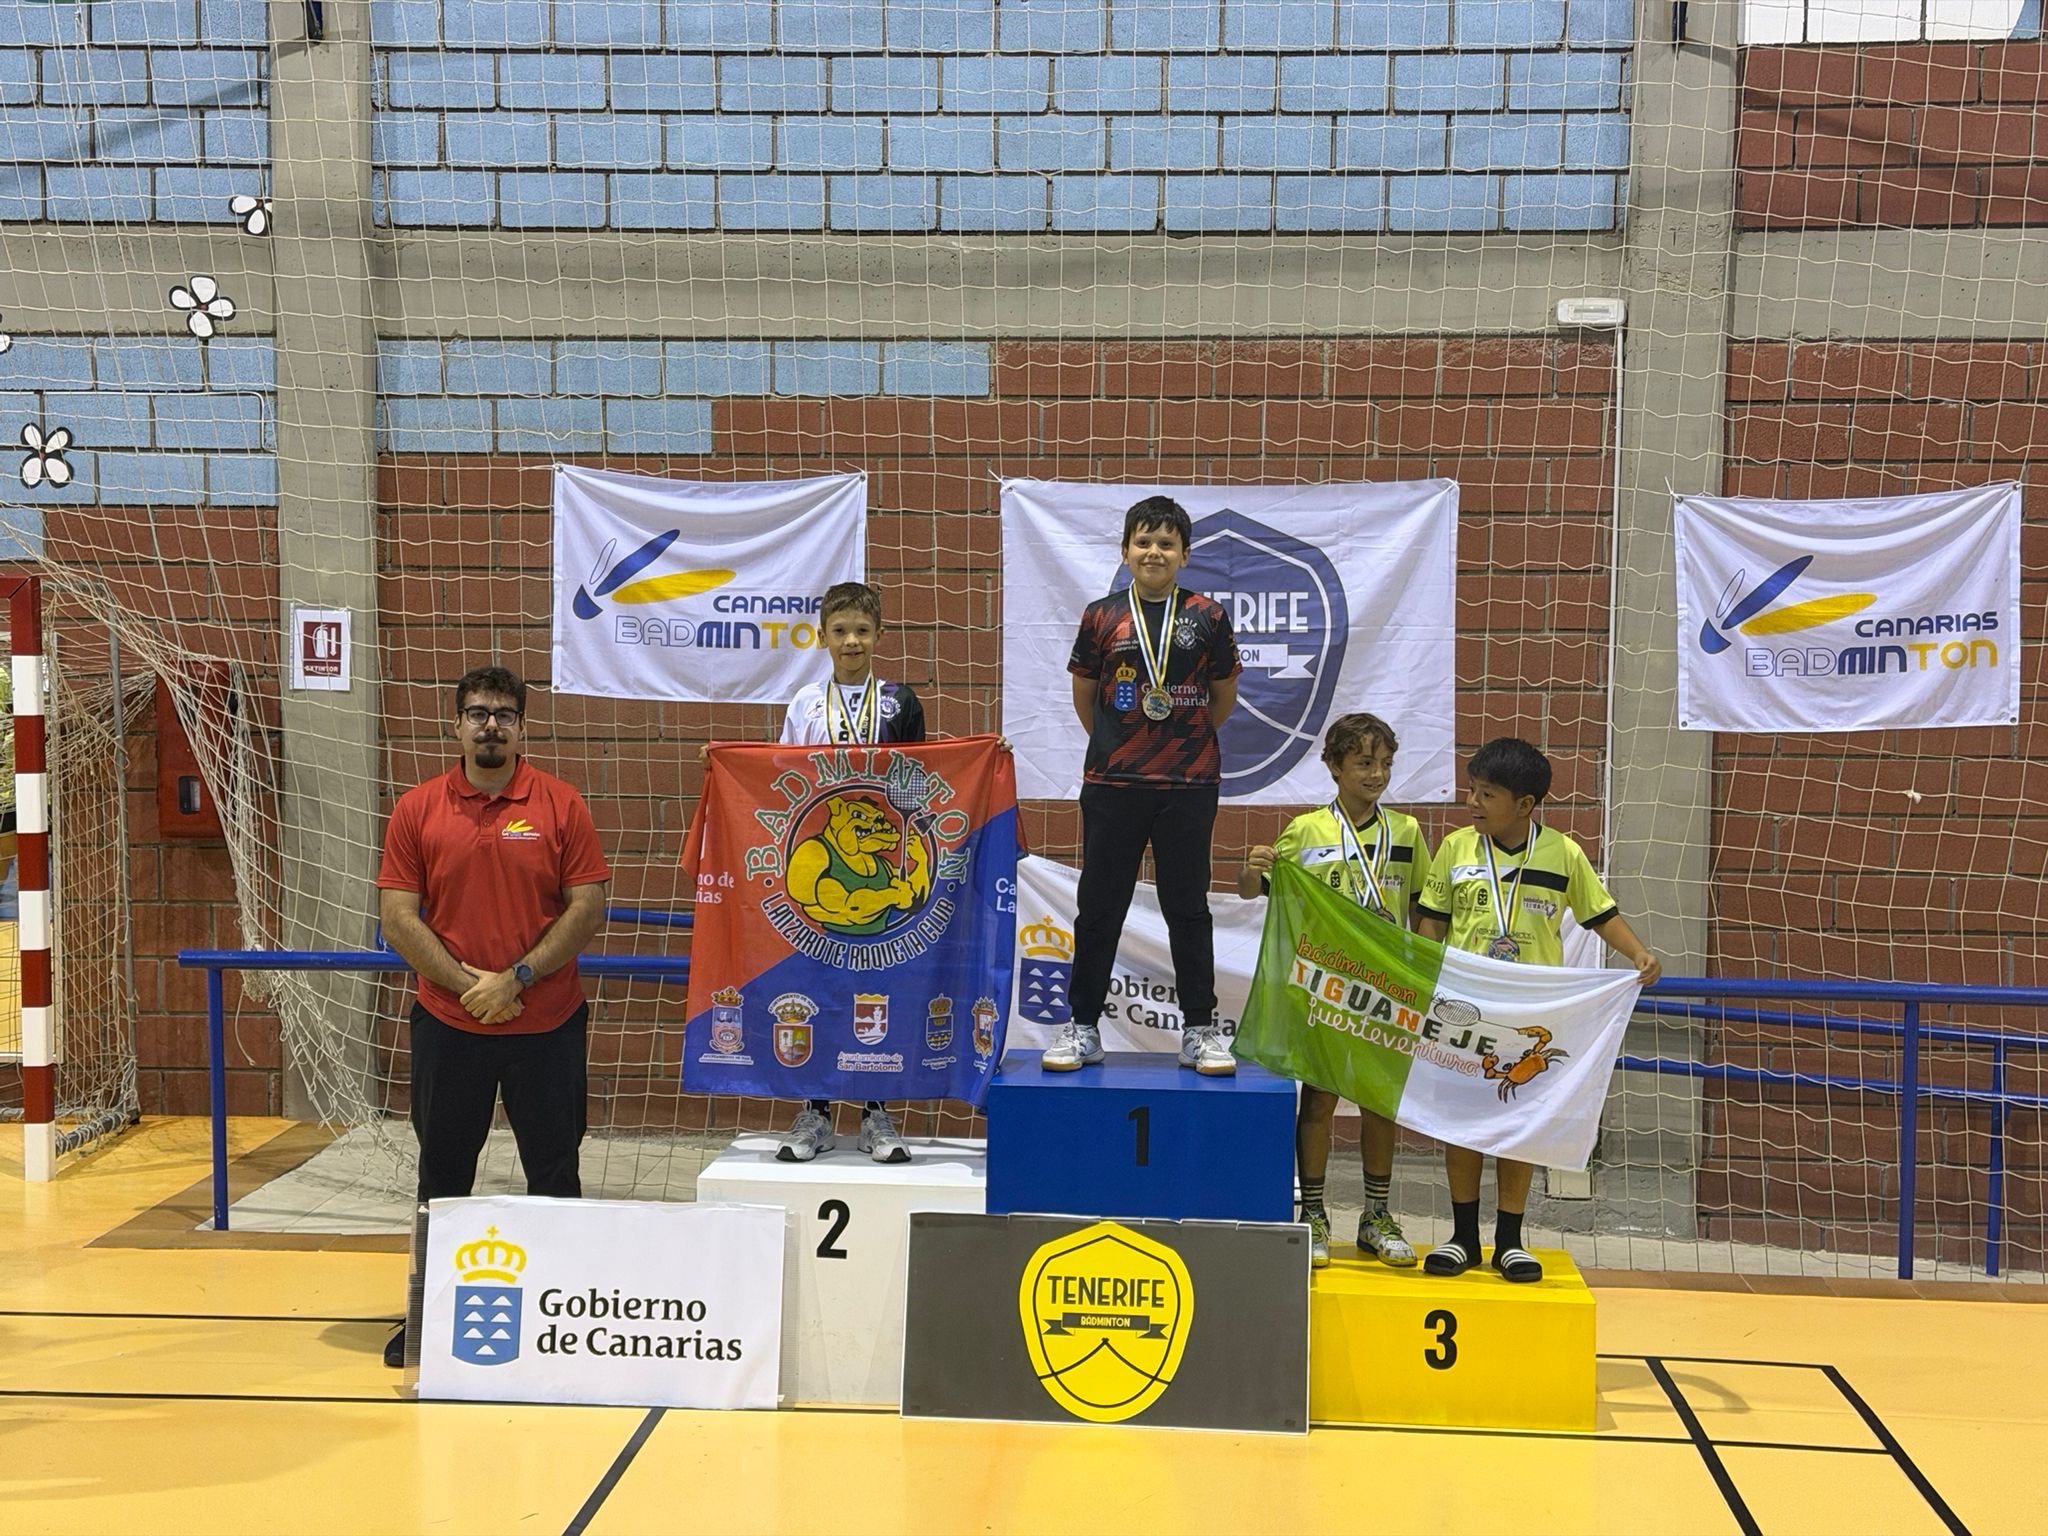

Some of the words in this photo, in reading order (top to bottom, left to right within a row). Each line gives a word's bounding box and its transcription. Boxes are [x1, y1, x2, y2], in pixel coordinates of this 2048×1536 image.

[713, 595, 825, 614] CANARIA
[614, 615, 822, 650] BADMINTO
[1855, 611, 1999, 638] CANARIAS
[1745, 639, 1998, 677] BADMINTON
[1141, 681, 1198, 695] Gierno
[744, 747, 971, 884] BADMINTON
[761, 891, 849, 969] LANZAROTE
[847, 930, 928, 971] RAQUETA
[917, 896, 956, 944] CLUB
[1108, 975, 1178, 1004] obier
[1306, 996, 1479, 1078] fuerteventura
[1127, 1105, 1150, 1167] 1
[816, 1198, 851, 1260] 2
[538, 1288, 707, 1323] Gobierno
[1046, 1274, 1166, 1309] TENERIFE
[536, 1324, 578, 1355] de
[585, 1327, 743, 1361] Canarias
[1423, 1309, 1458, 1370] 3
